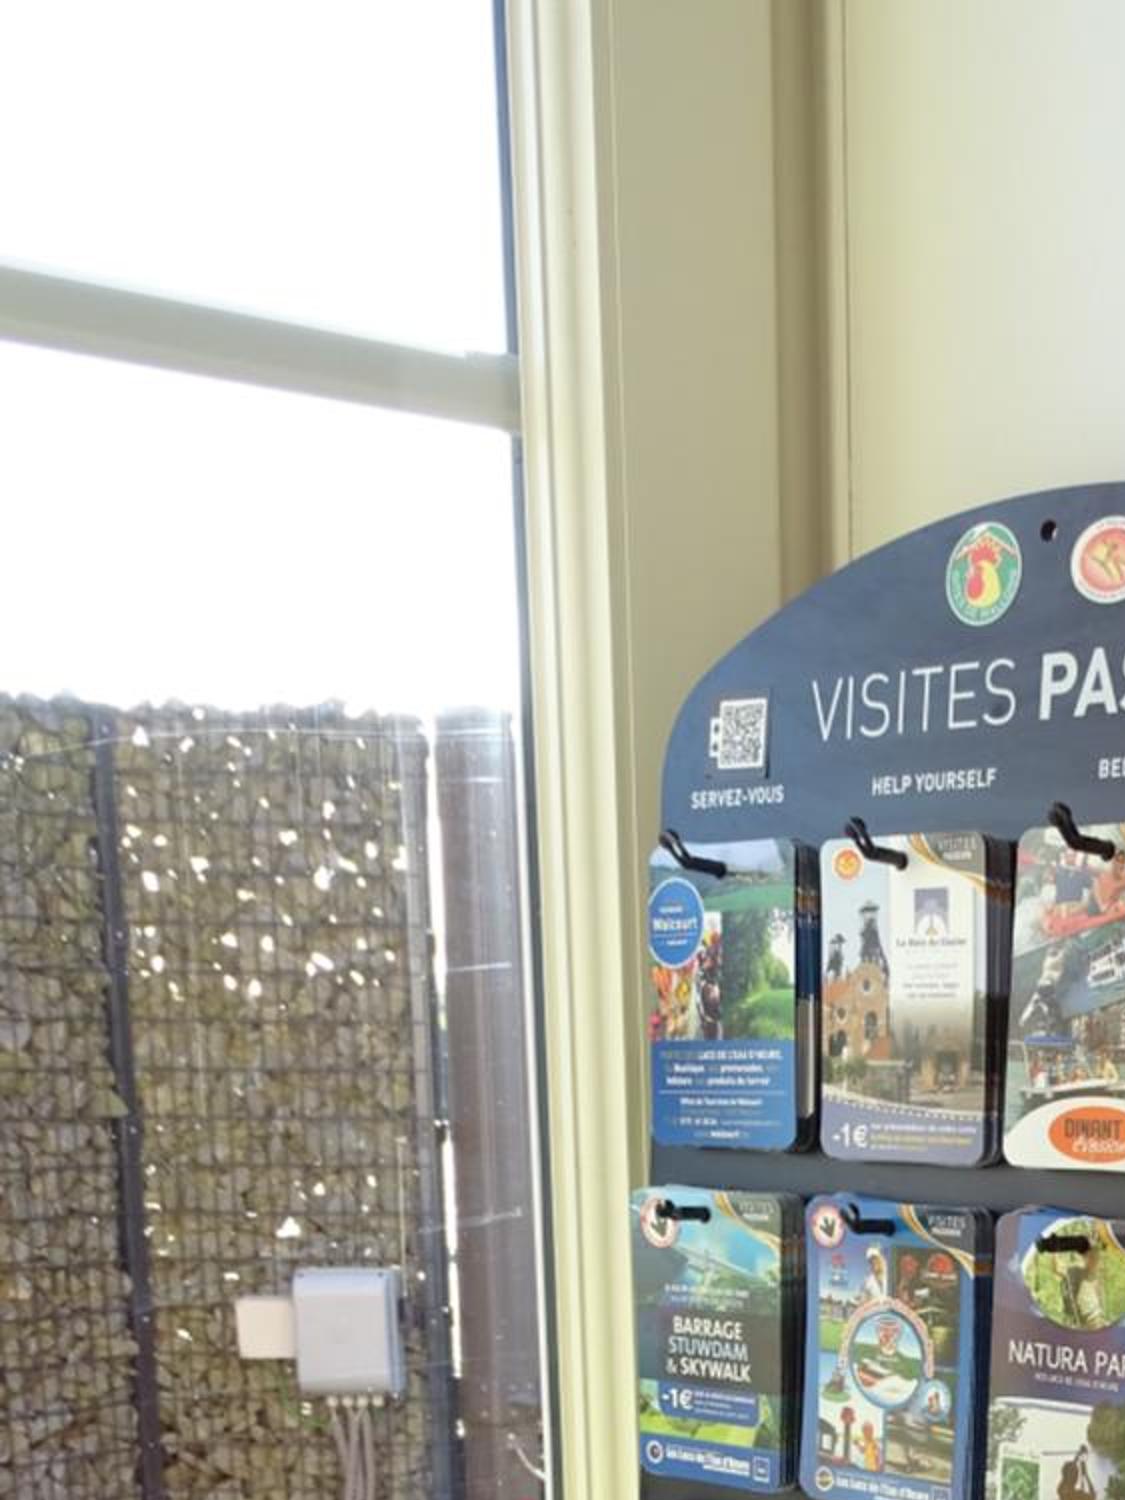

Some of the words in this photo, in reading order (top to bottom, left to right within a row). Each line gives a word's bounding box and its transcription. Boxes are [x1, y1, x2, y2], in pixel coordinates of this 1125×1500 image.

[813, 658, 1016, 743] VISITES
[872, 775, 911, 796] HELP
[915, 767, 997, 793] YOURSELF
[691, 785, 784, 809] SERVEZ-VOUS
[1064, 1118, 1123, 1140] DINANT
[672, 1315, 743, 1341] BARRAGE
[668, 1336, 748, 1362] STUWDAM
[1008, 1340, 1088, 1374] NATURA
[666, 1358, 678, 1375] &
[680, 1357, 751, 1383] SKYWALK
